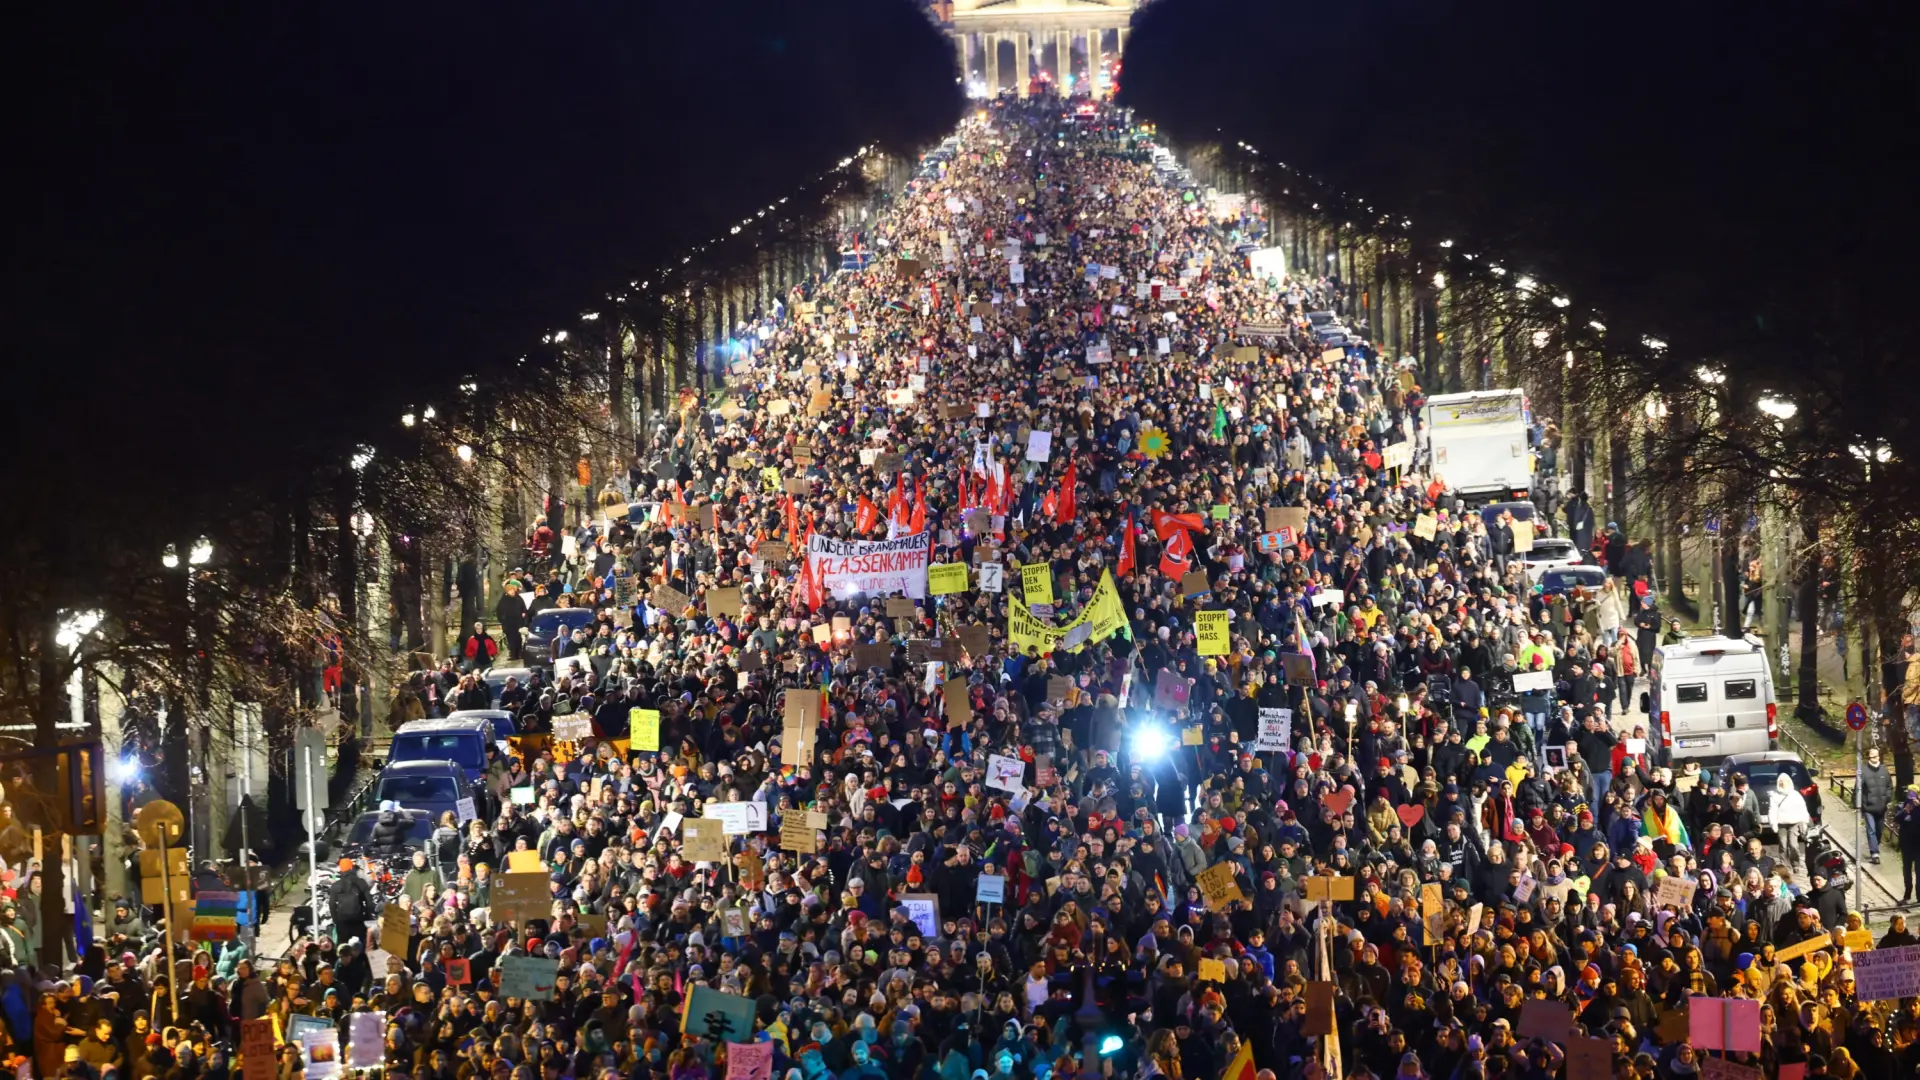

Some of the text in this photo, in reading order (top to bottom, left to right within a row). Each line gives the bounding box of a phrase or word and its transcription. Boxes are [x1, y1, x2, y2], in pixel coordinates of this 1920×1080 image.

[811, 531, 928, 556] UNSERE BRANDMAUER
[817, 550, 927, 575] KLASSENKAMPF
[1023, 565, 1049, 576] STOPPT
[1024, 577, 1038, 585] DEN
[1025, 585, 1045, 594] HASS.
[1198, 613, 1227, 622] STOPPT
[1199, 623, 1214, 631] DEN
[1199, 632, 1221, 641] HASS.
